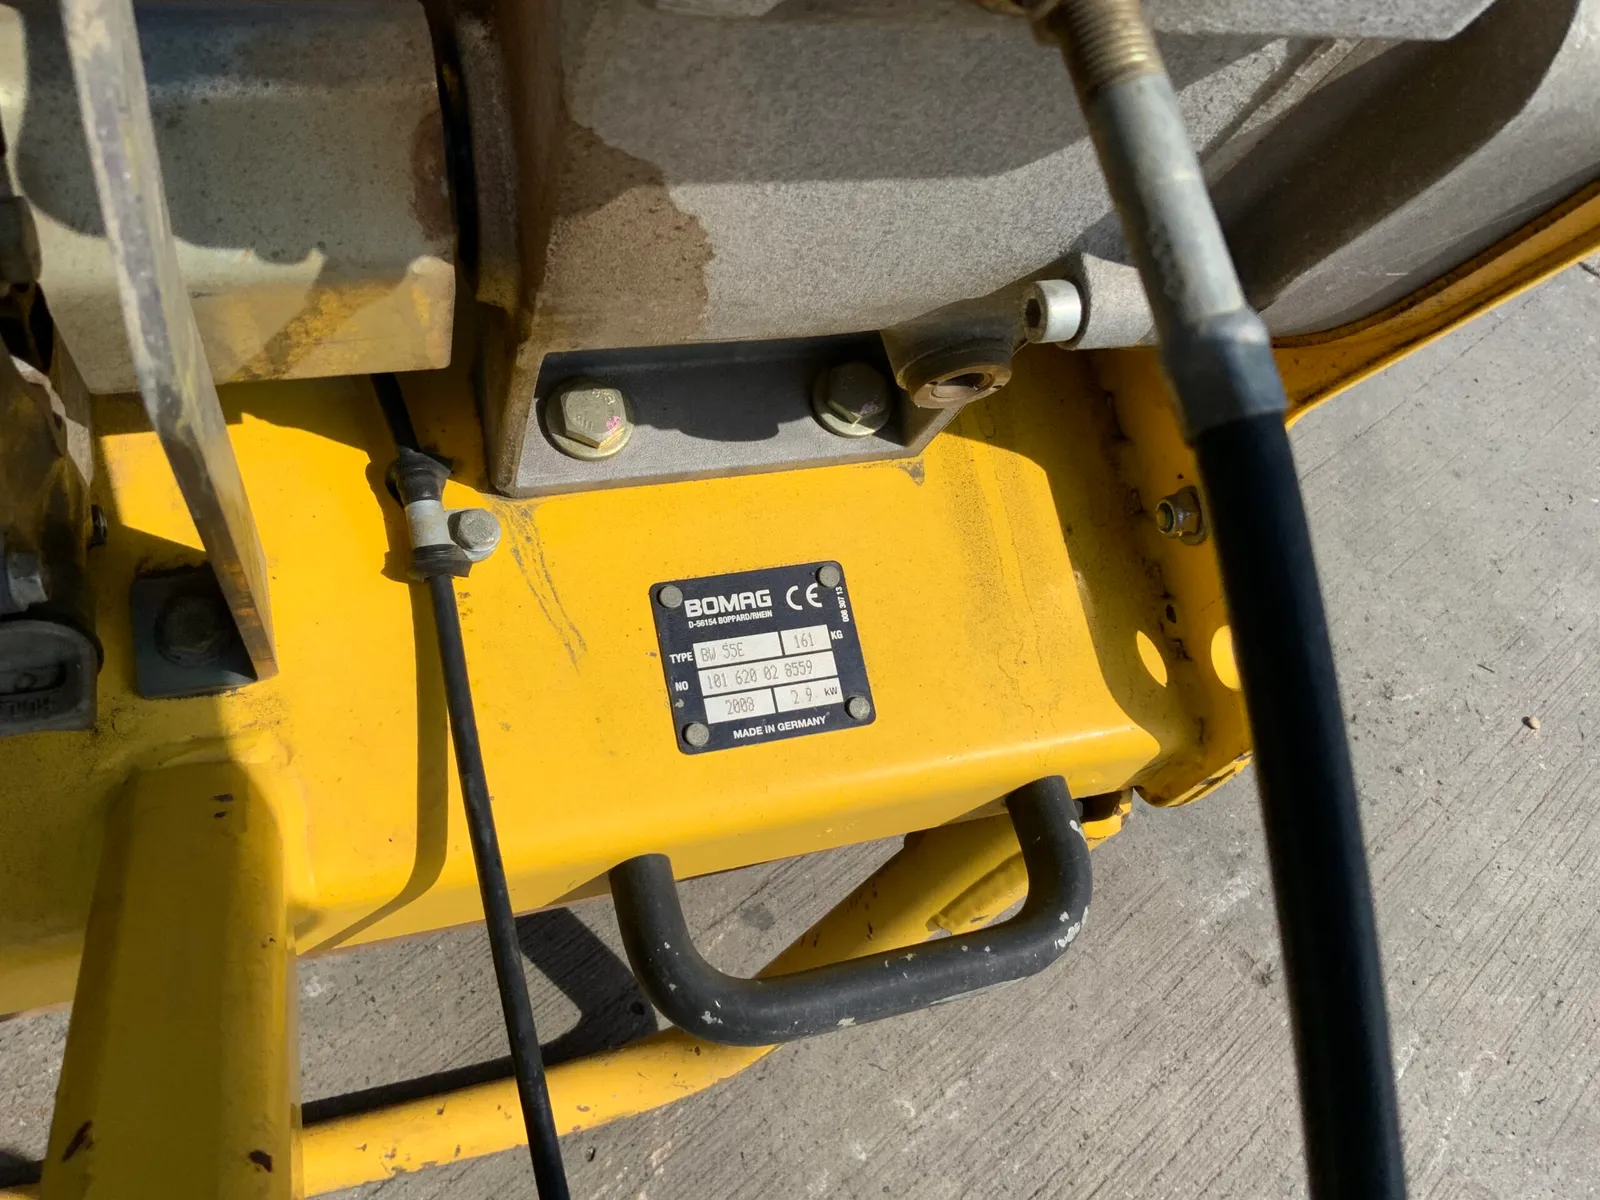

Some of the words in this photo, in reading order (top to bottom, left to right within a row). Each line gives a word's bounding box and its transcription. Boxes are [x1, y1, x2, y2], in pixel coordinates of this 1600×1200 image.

[835, 586, 844, 595] 13
[684, 589, 773, 618] BOMAG
[837, 596, 847, 609] 307
[688, 618, 718, 629] D-56154
[718, 610, 773, 625] BOPPARD/RHEIN
[794, 631, 815, 649] 161
[830, 629, 844, 640] KG
[669, 651, 694, 664] TYPE
[700, 646, 717, 662] BW
[674, 680, 689, 692] NO
[707, 672, 728, 690] 101
[735, 668, 758, 685] 620
[763, 665, 779, 681] 02
[784, 659, 813, 678] 8559
[824, 686, 839, 697] kW
[733, 726, 764, 740] MADE
[764, 723, 776, 734] IN
[777, 715, 826, 732] GERMANY
